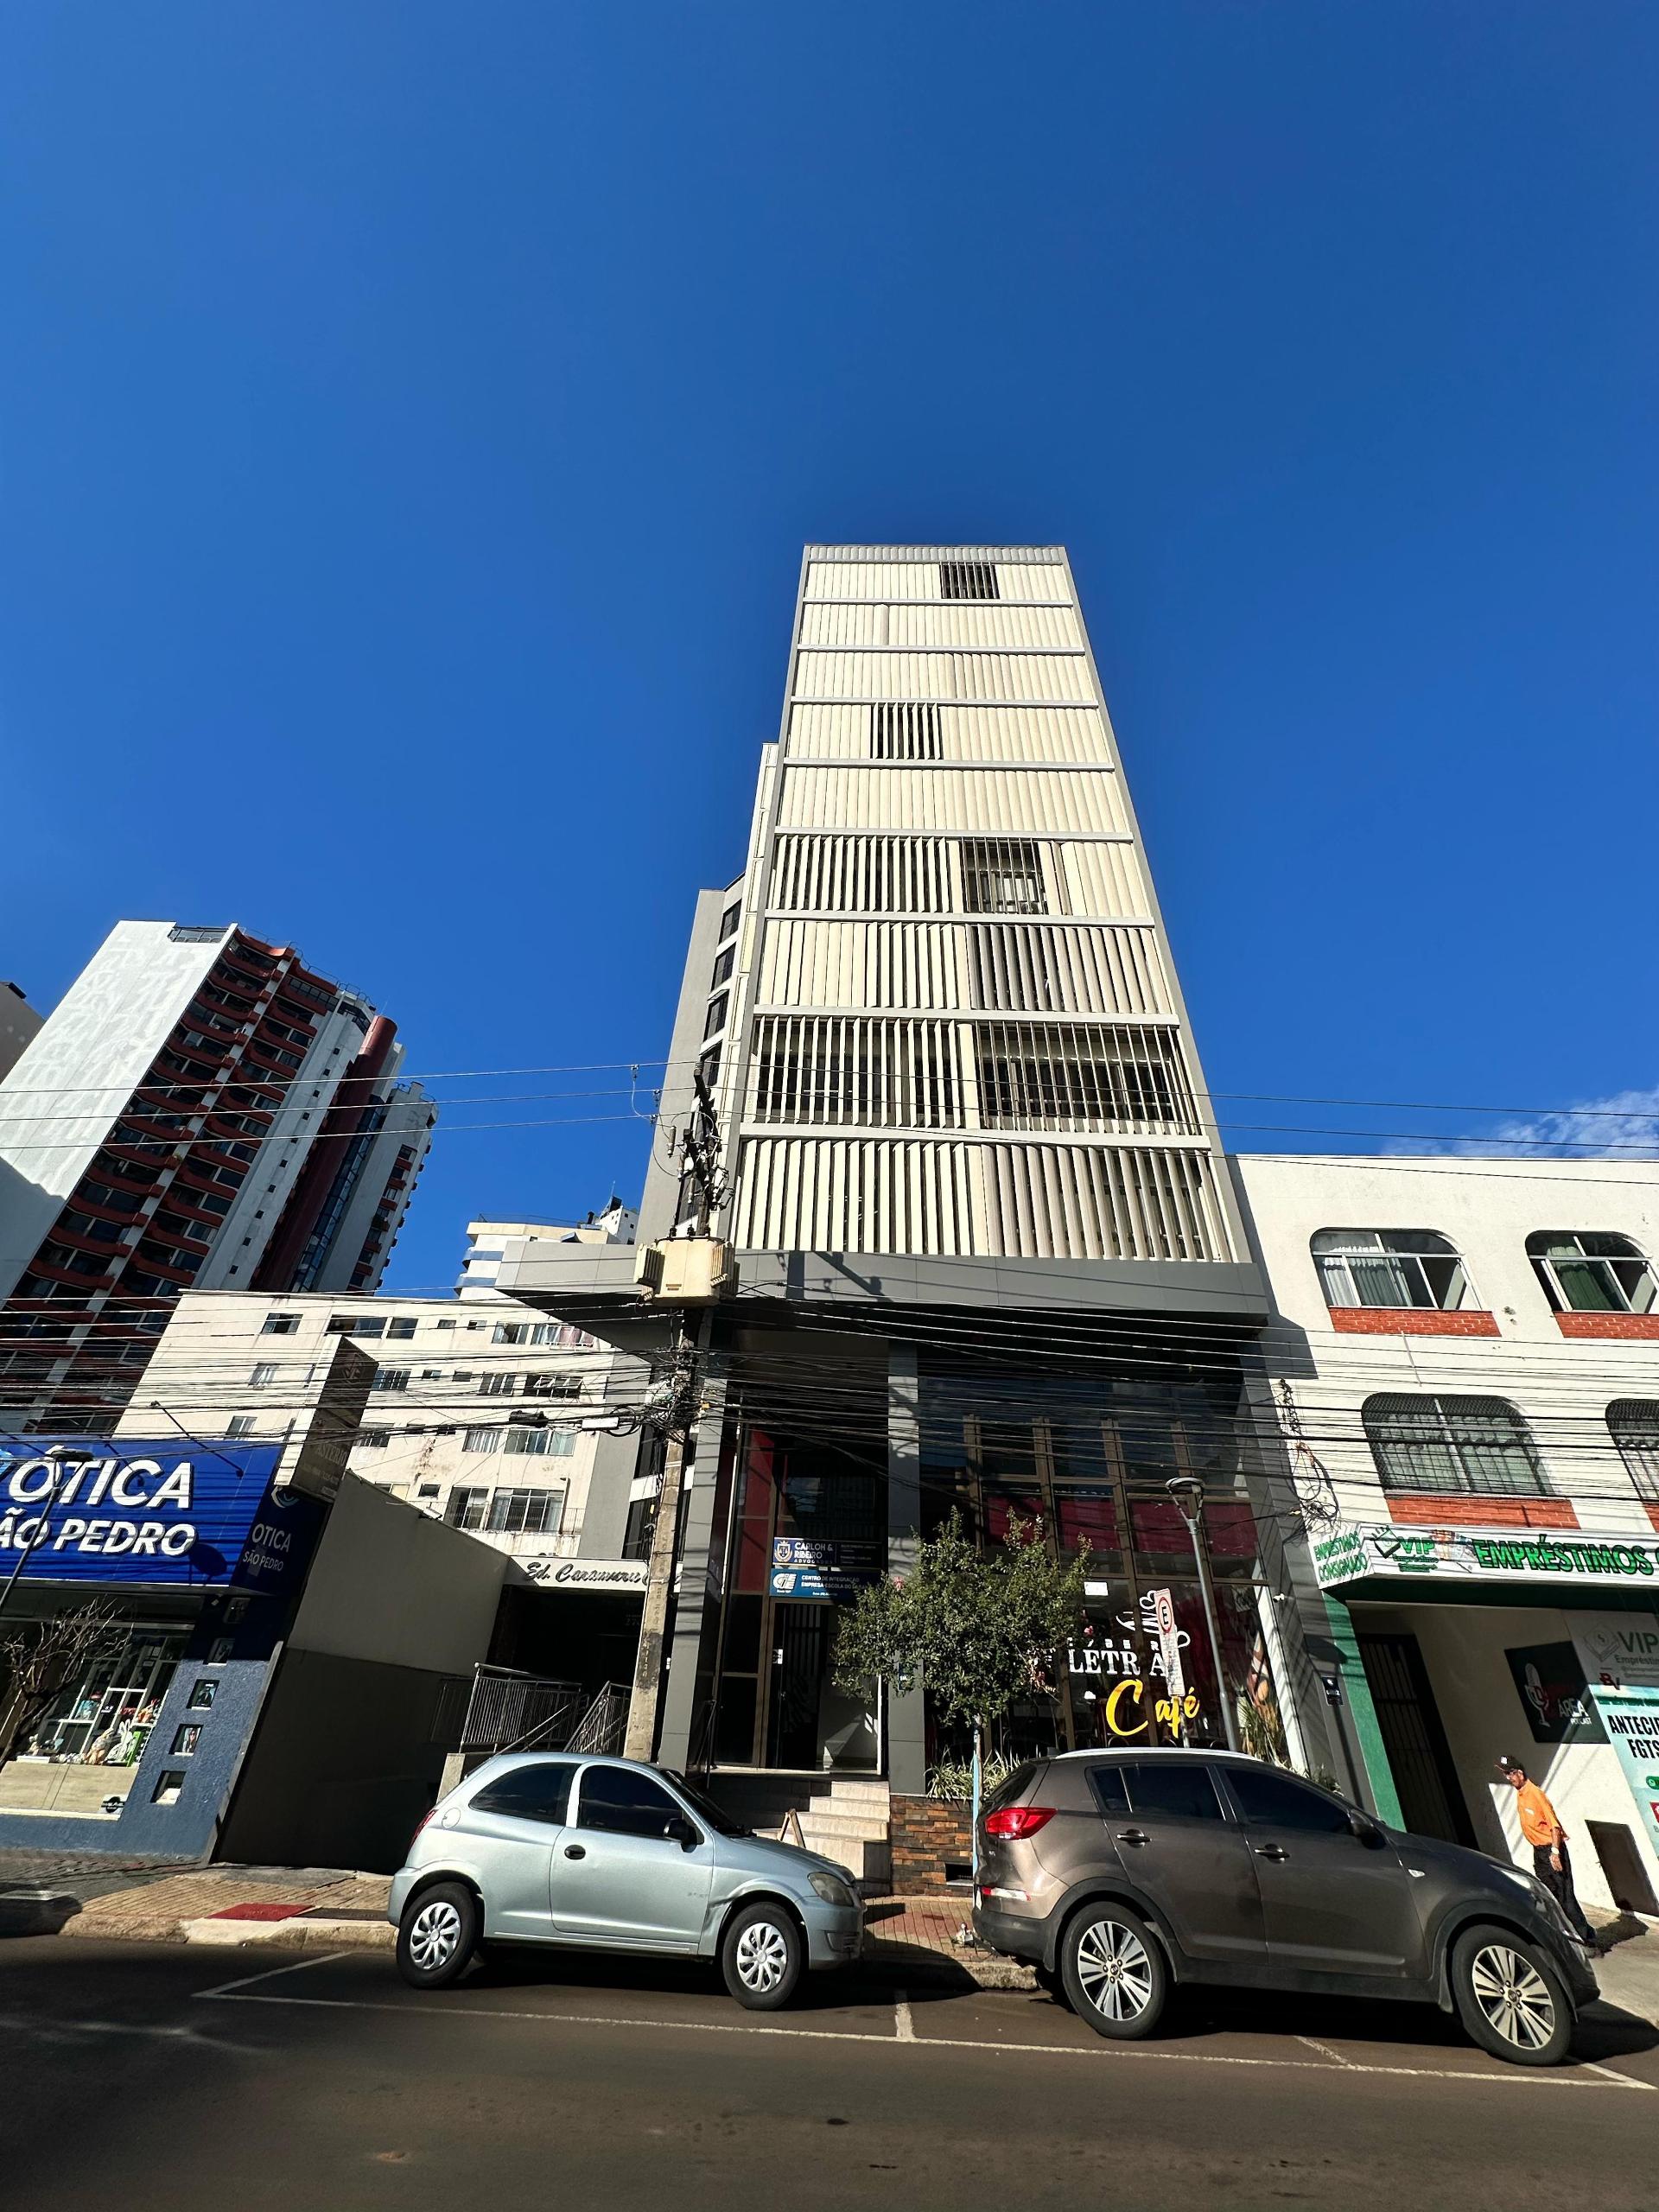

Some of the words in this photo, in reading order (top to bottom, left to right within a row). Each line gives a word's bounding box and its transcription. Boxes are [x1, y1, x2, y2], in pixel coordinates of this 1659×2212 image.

[9, 1445, 192, 1509] ÓTICA
[54, 1518, 197, 1556] PEDRO
[1397, 1536, 1435, 1554] VIP
[243, 1550, 260, 1565] SÃO
[259, 1555, 284, 1572] PEDRO
[794, 1551, 823, 1560] RIBEIRO
[1471, 1534, 1655, 1576] EMPRÉSTIMOS
[526, 1561, 550, 1580] Ed.
[555, 1563, 641, 1583] Caramuru
[1162, 1606, 1169, 1625] E
[1618, 1631, 1659, 1653] VIP
[1106, 1679, 1200, 1738] Café
